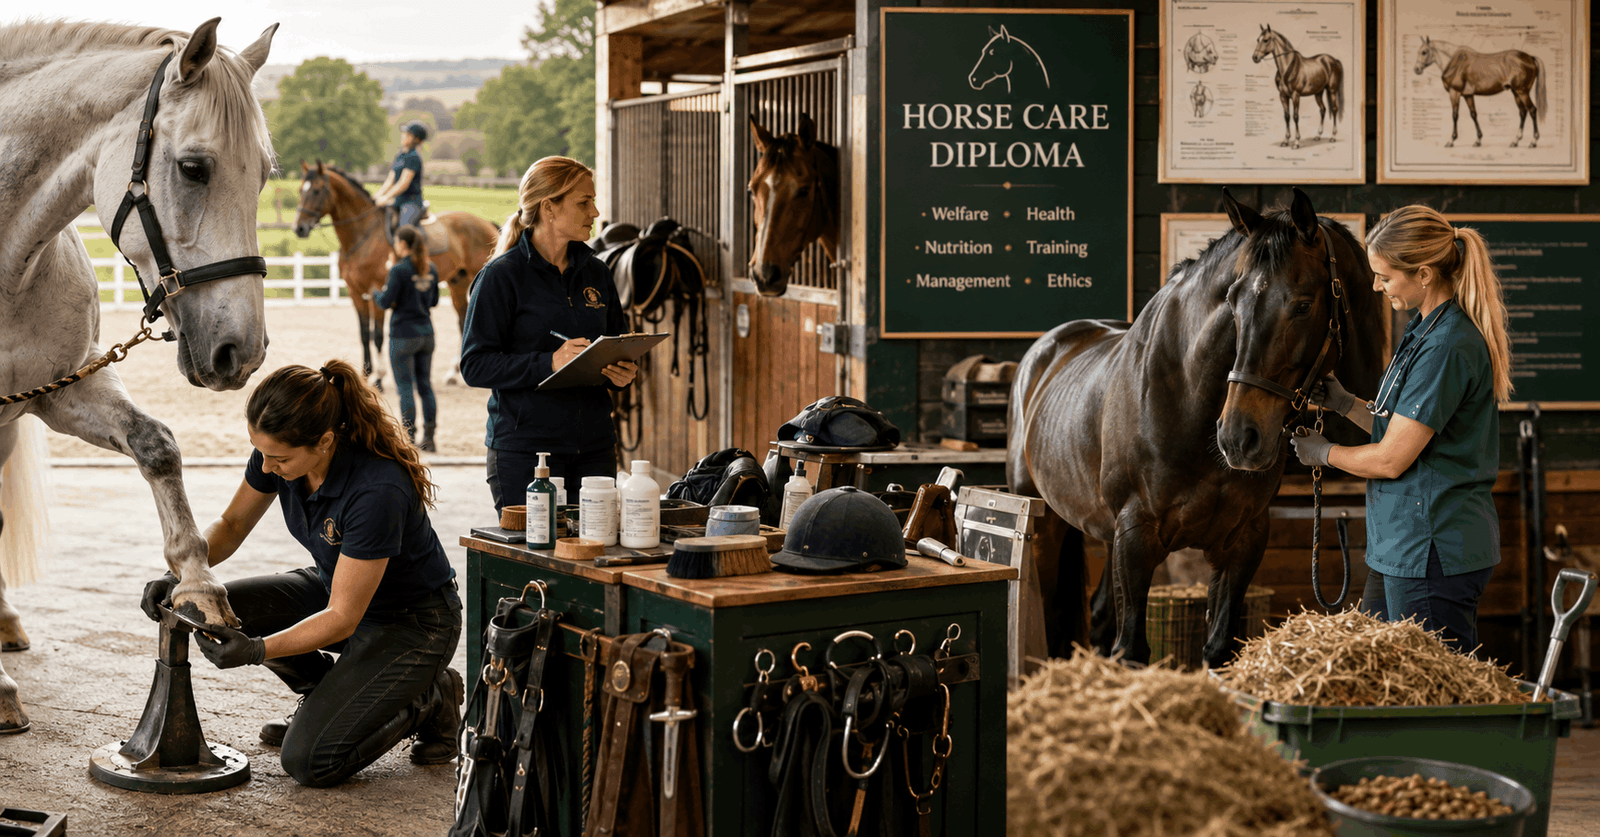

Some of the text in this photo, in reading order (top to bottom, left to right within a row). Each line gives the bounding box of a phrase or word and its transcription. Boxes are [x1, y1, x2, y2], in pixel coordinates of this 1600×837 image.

[903, 104, 1109, 129] HORSE CARE
[930, 142, 1084, 167] DIPLOMA
[932, 206, 1075, 221] Welfare Health
[925, 240, 1088, 258] Nutrition Training
[917, 273, 1092, 291] Management Ethics
